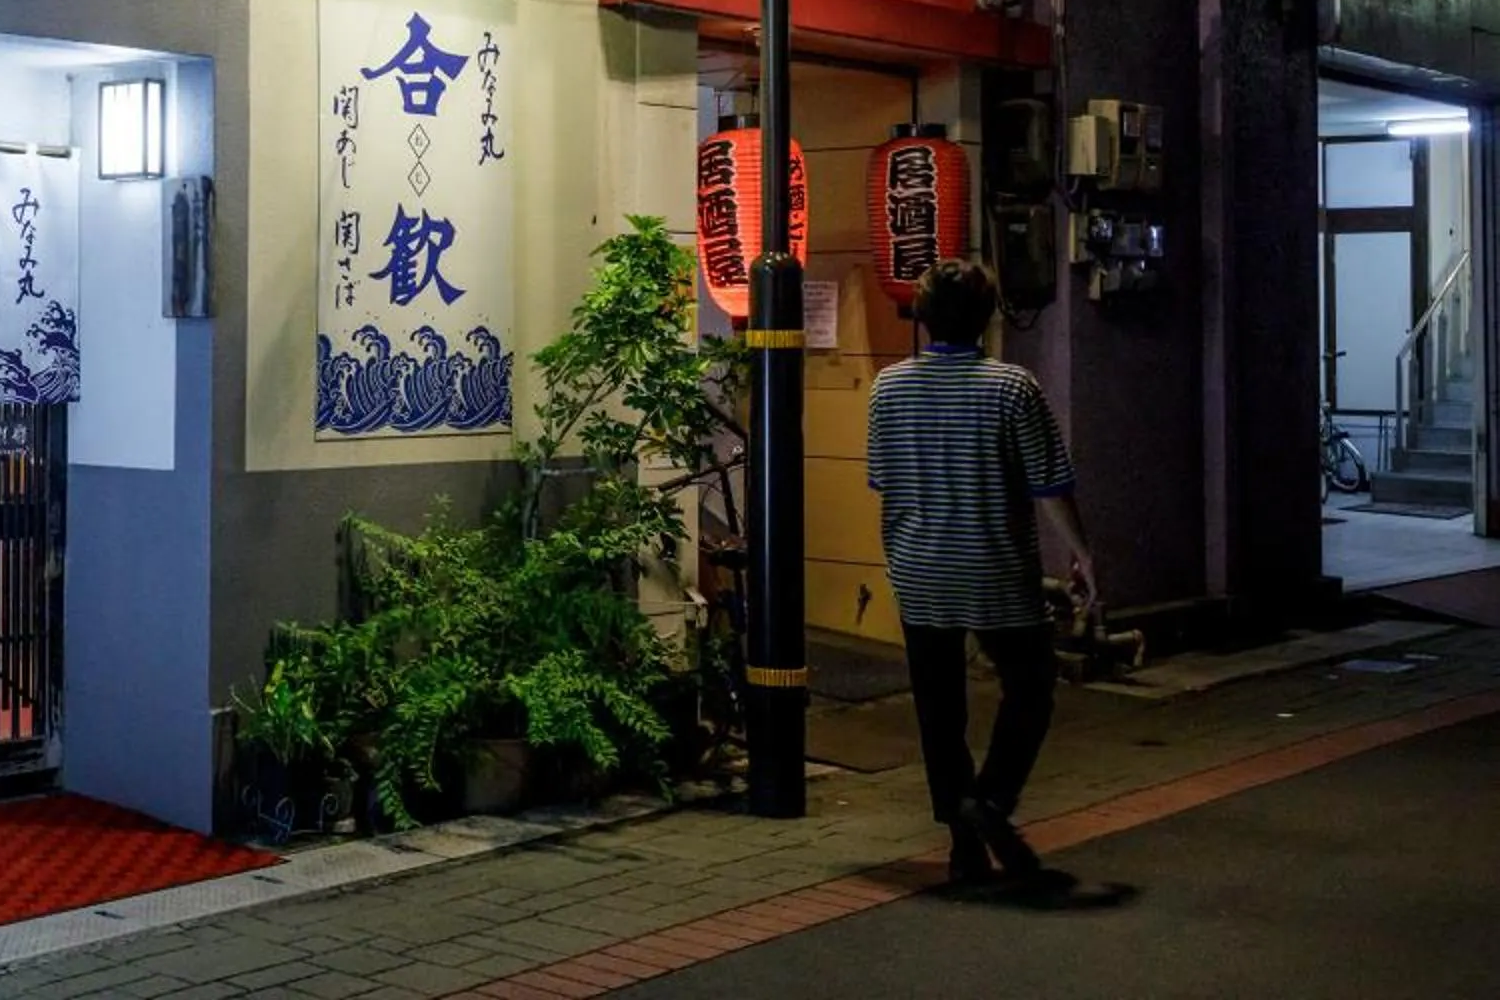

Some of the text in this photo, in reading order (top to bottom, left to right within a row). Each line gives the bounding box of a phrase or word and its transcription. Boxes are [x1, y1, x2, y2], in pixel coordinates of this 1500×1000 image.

[361, 12, 470, 306] 合 歓
[478, 32, 505, 166] みなみ丸
[13, 188, 45, 303] みなみ丸
[333, 85, 360, 309] 関あじ 関さば
[699, 140, 749, 288] 居酒屋
[888, 147, 940, 282] 居酒屋
